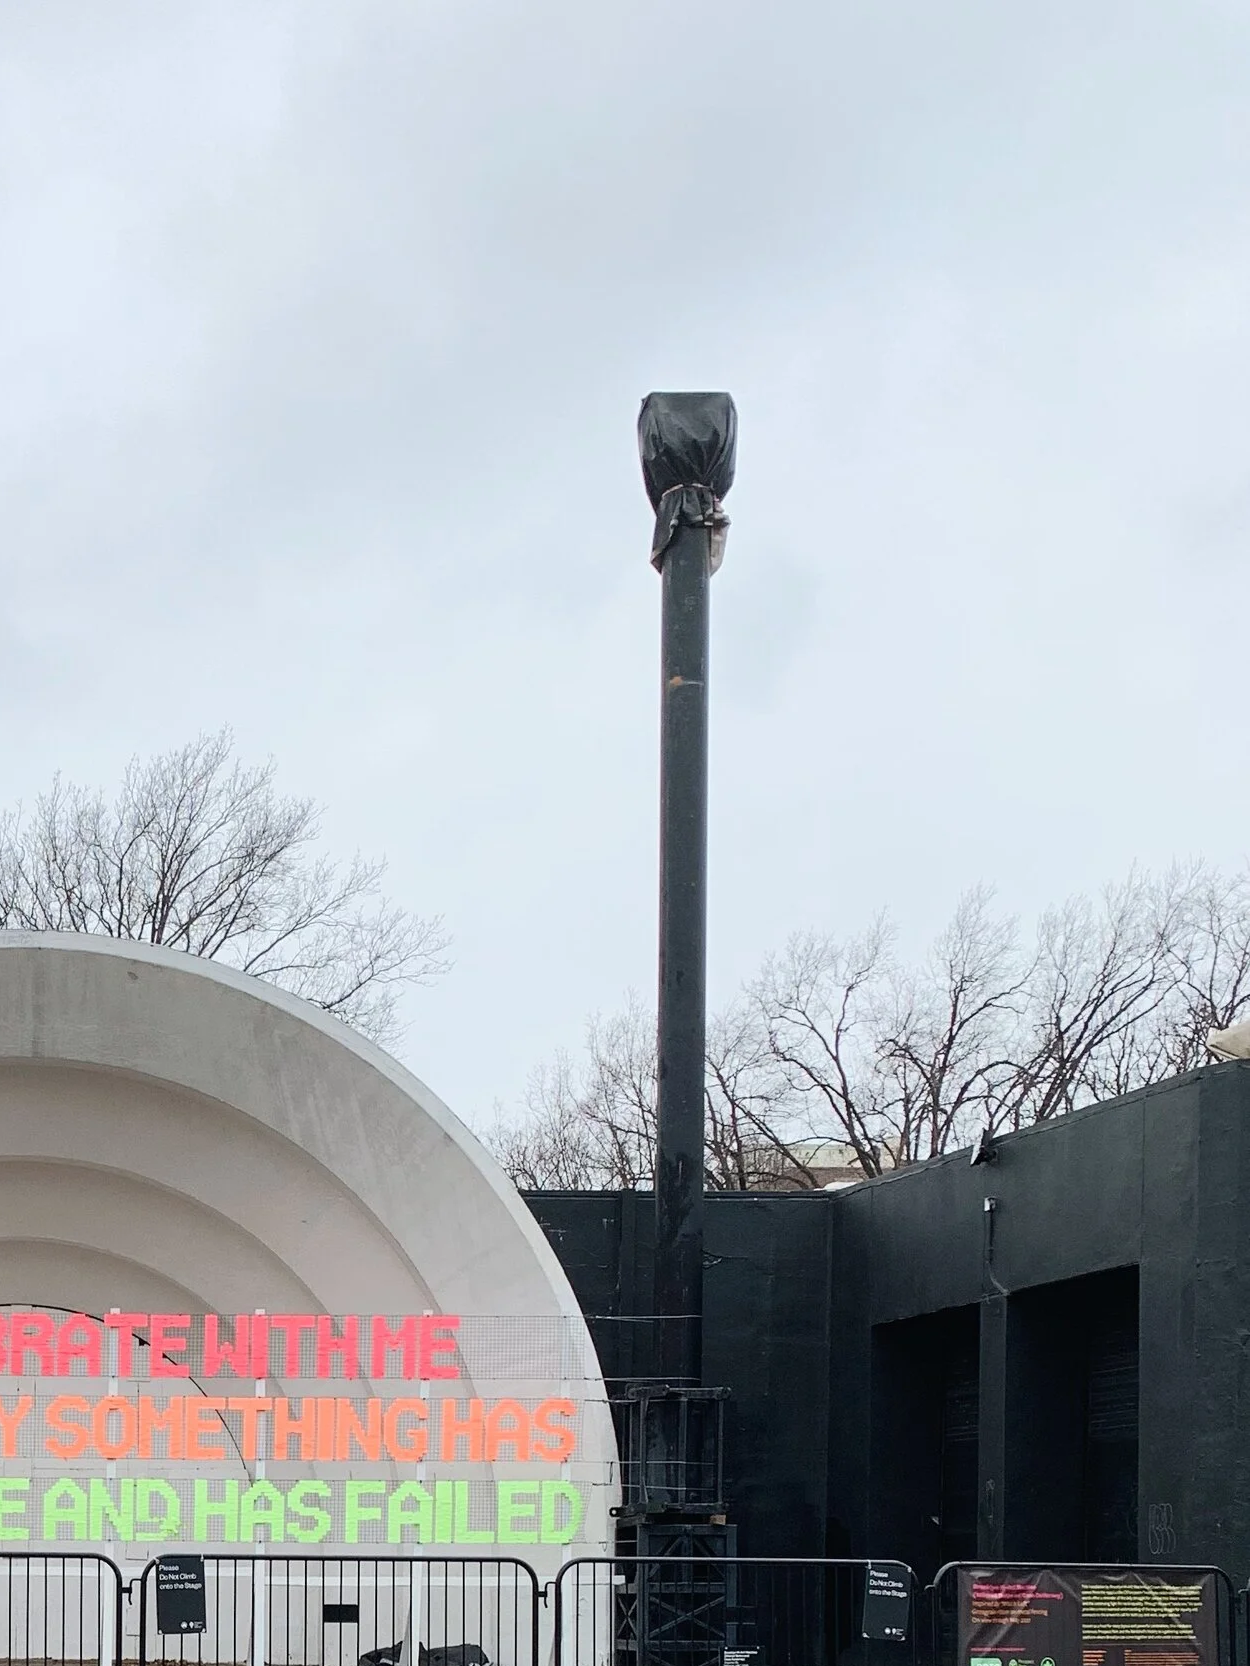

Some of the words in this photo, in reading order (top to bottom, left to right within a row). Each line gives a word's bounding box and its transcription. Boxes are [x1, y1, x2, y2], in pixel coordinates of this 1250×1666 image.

[203, 1313, 359, 1379] WITH
[371, 1315, 461, 1380] ME
[45, 1396, 427, 1462] SOMETHING
[441, 1398, 577, 1462] HAS
[43, 1477, 182, 1542] AND
[194, 1479, 332, 1543] HAS
[344, 1480, 585, 1543] FAILED
